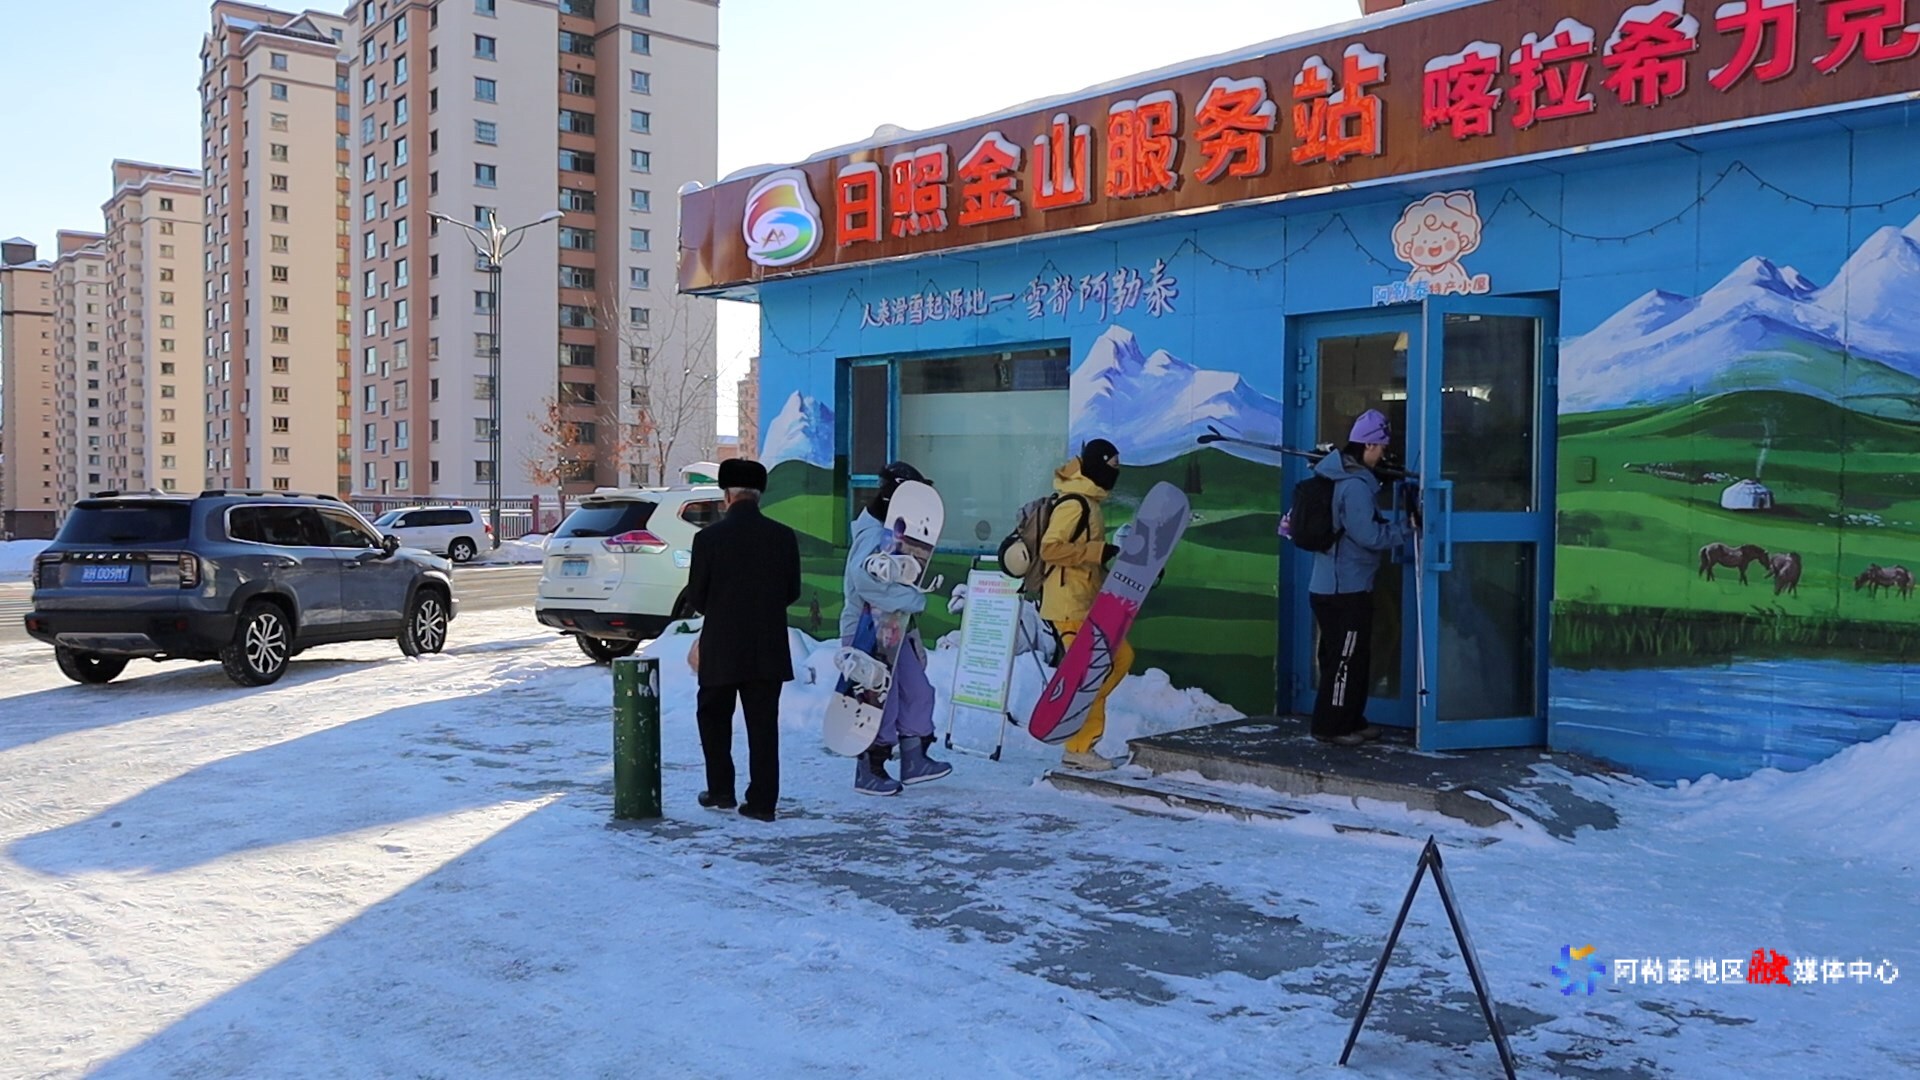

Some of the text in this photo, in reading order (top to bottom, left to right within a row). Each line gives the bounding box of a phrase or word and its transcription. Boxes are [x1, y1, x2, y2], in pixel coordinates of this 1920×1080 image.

[837, 44, 1387, 247] 日照金山服务站
